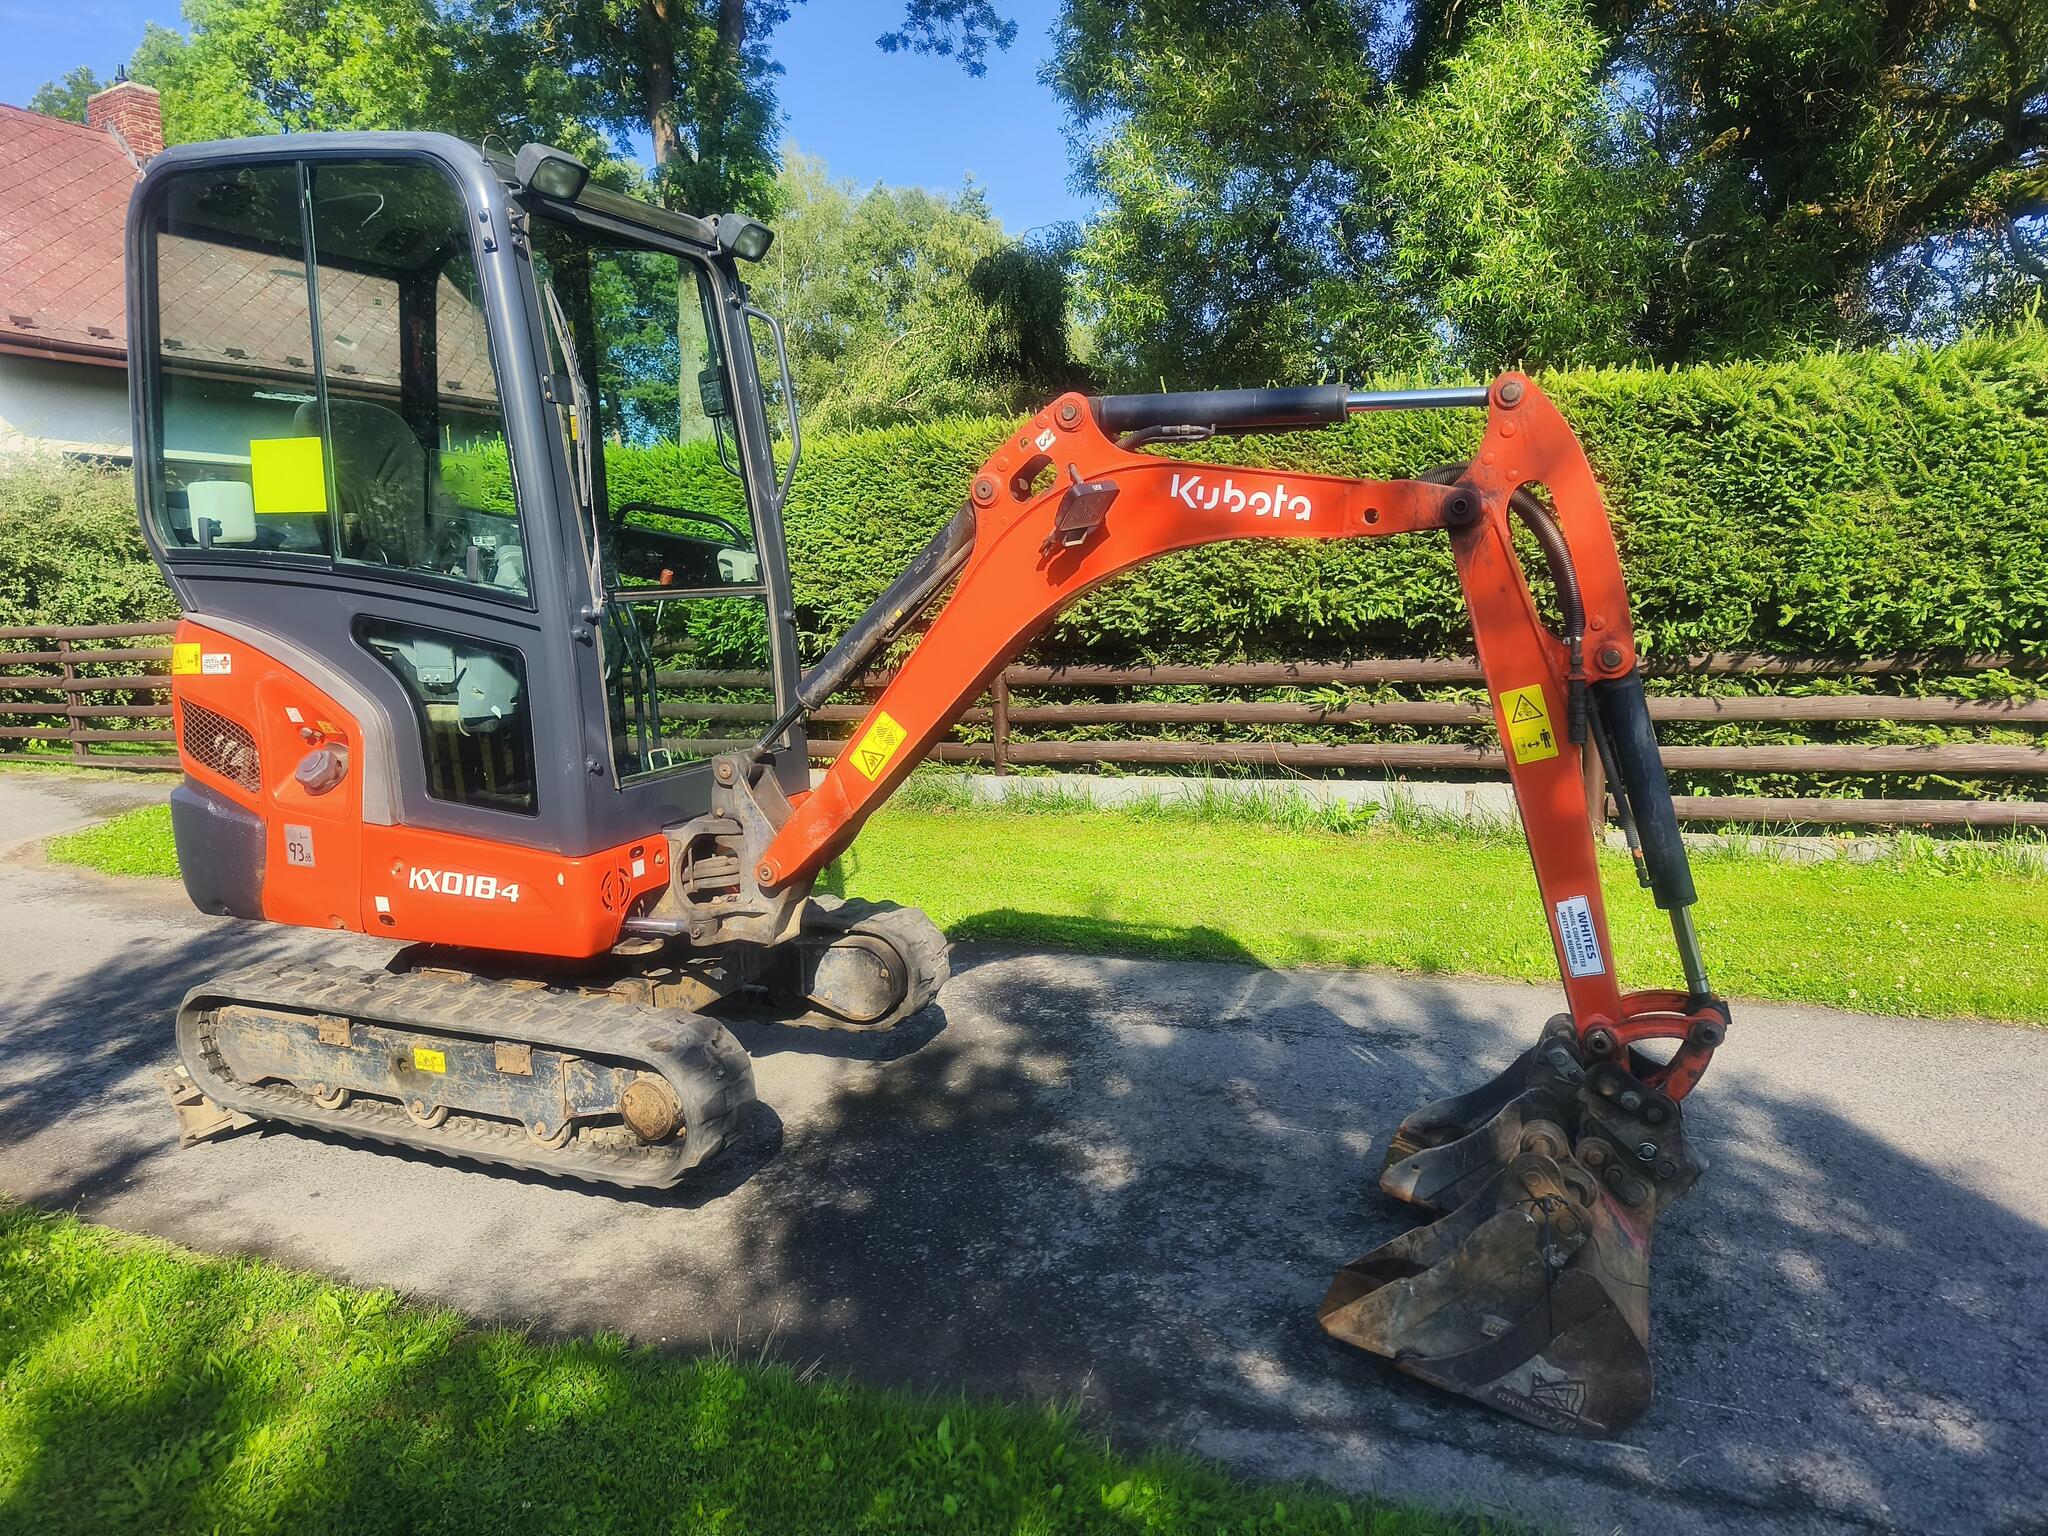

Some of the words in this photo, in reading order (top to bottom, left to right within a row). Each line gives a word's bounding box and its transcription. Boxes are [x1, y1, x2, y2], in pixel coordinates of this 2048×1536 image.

[1170, 473, 1312, 521] Kubota
[289, 842, 304, 862] 93
[408, 866, 520, 903] KX018-4
[1560, 911, 1569, 930] SAFETY
[1566, 940, 1578, 965] REQUIRED
[1567, 905, 1577, 927] MANUAL
[1572, 927, 1582, 950] COUPLER
[1577, 950, 1587, 968] FITTED
[1577, 911, 1597, 960] WHITES
